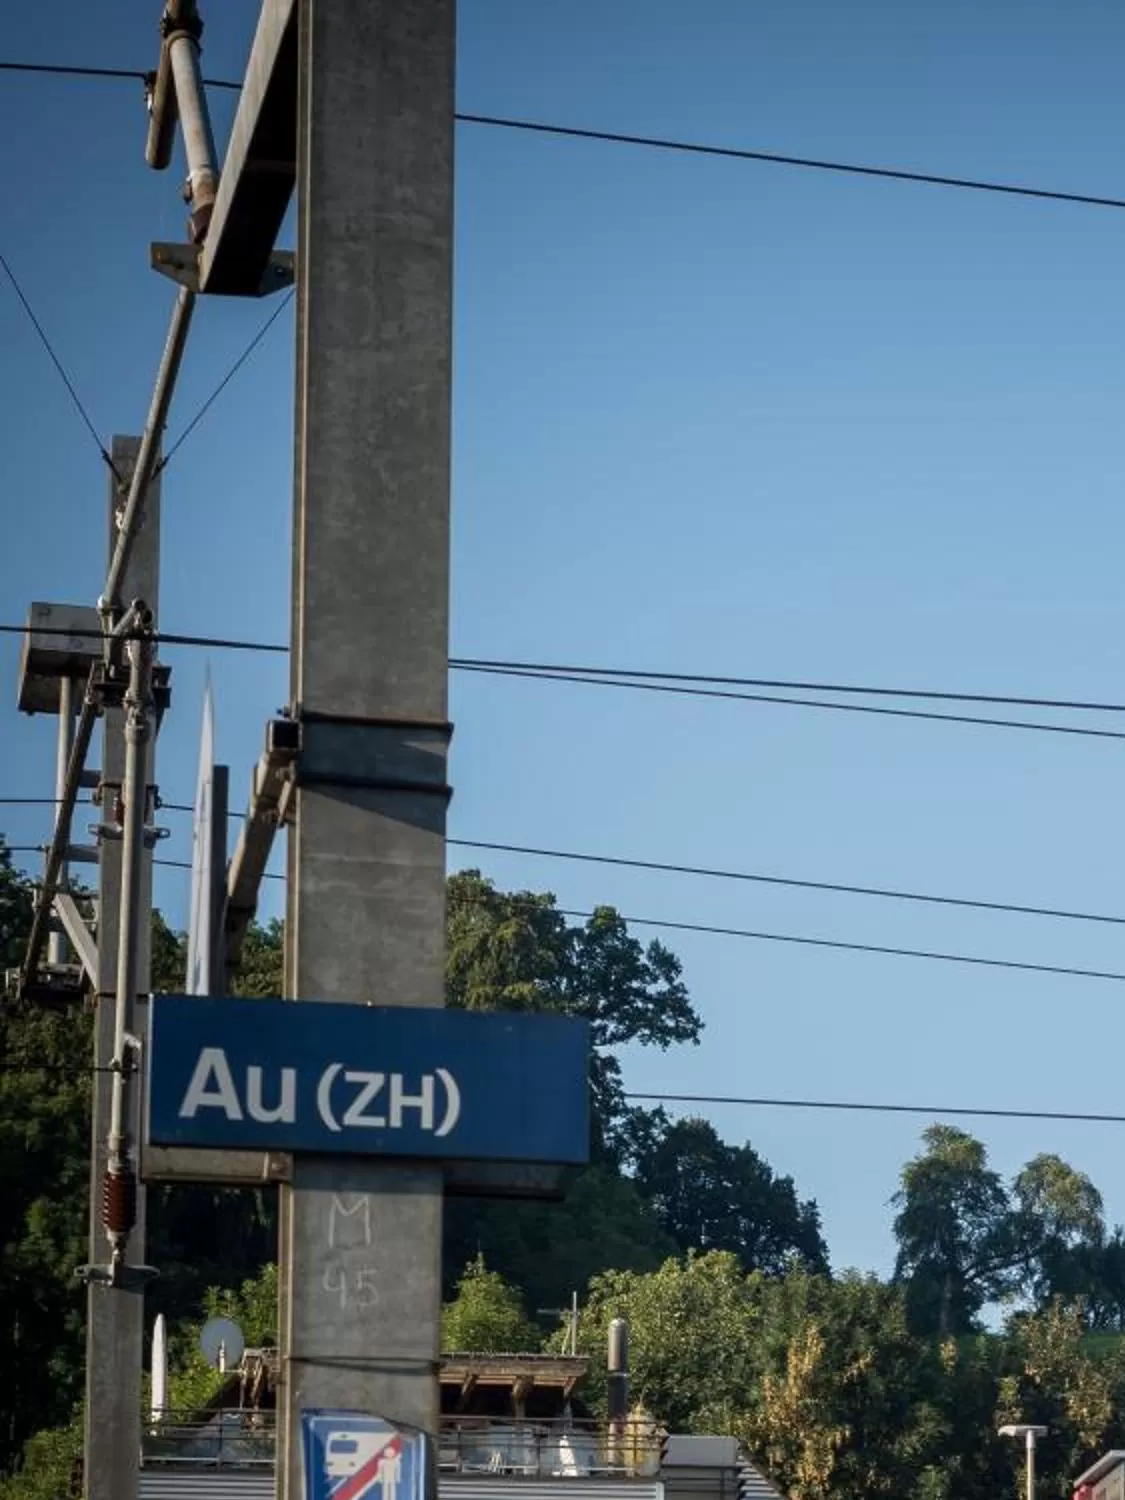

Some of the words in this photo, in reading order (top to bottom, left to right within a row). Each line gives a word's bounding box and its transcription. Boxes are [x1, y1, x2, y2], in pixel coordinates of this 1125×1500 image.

[178, 1046, 298, 1124] Au
[316, 1062, 462, 1136] (ZH)
[328, 1193, 371, 1249] M
